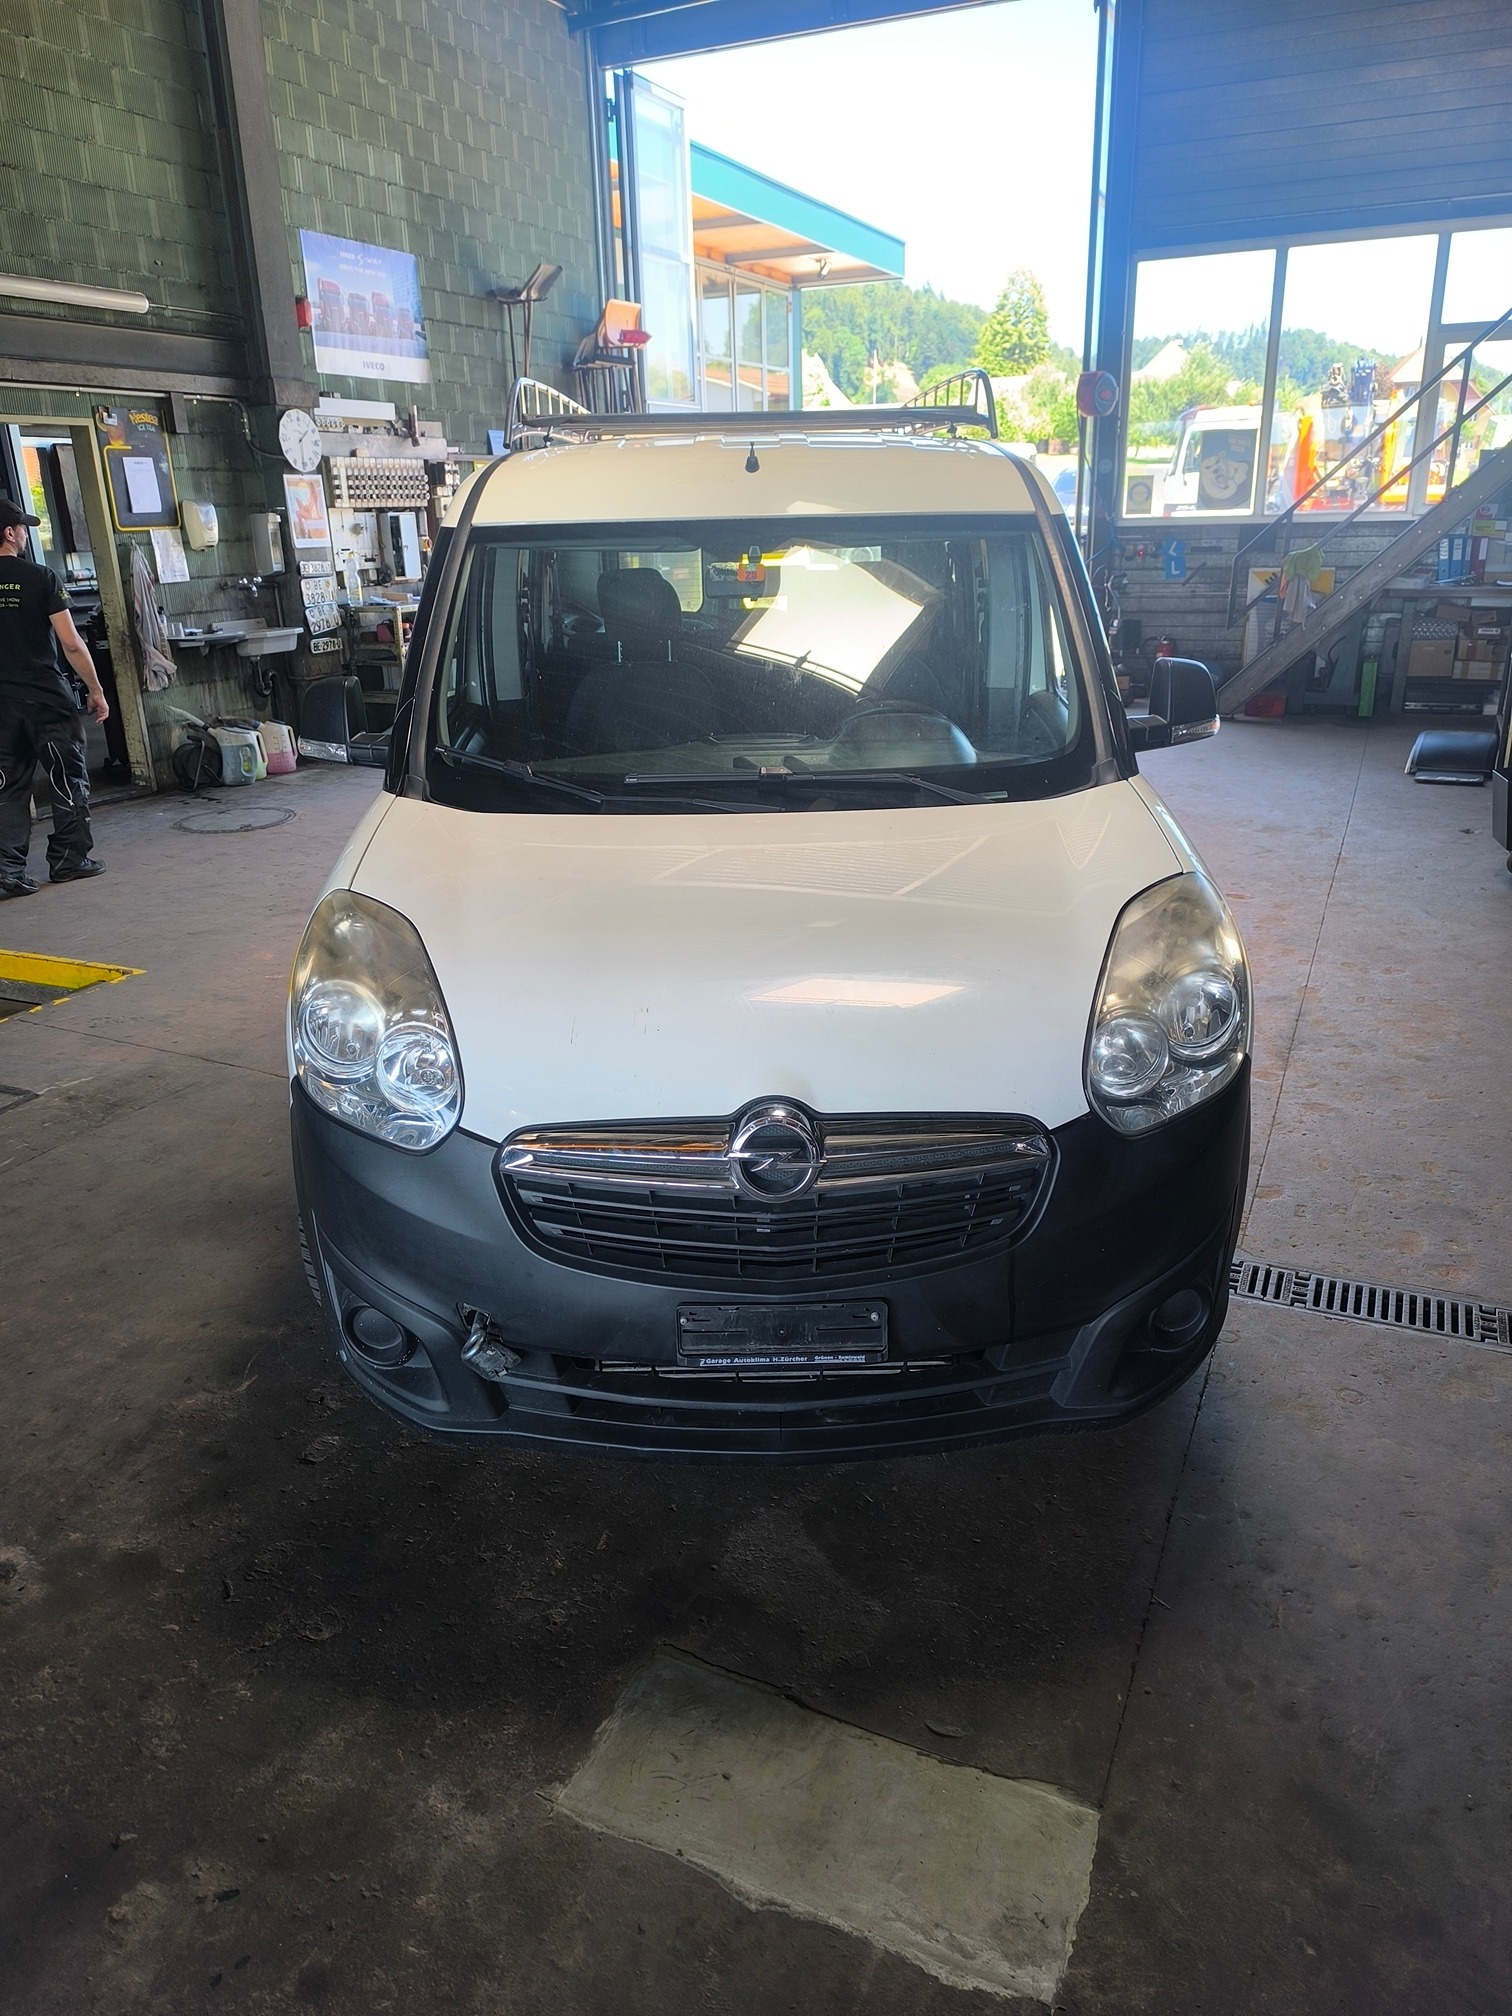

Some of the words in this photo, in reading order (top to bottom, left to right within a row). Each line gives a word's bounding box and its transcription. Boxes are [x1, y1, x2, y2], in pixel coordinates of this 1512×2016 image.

[363, 361, 385, 371] IVECO
[129, 412, 159, 426] Nestea
[1171, 561, 1180, 575] L
[314, 580, 323, 590] BE
